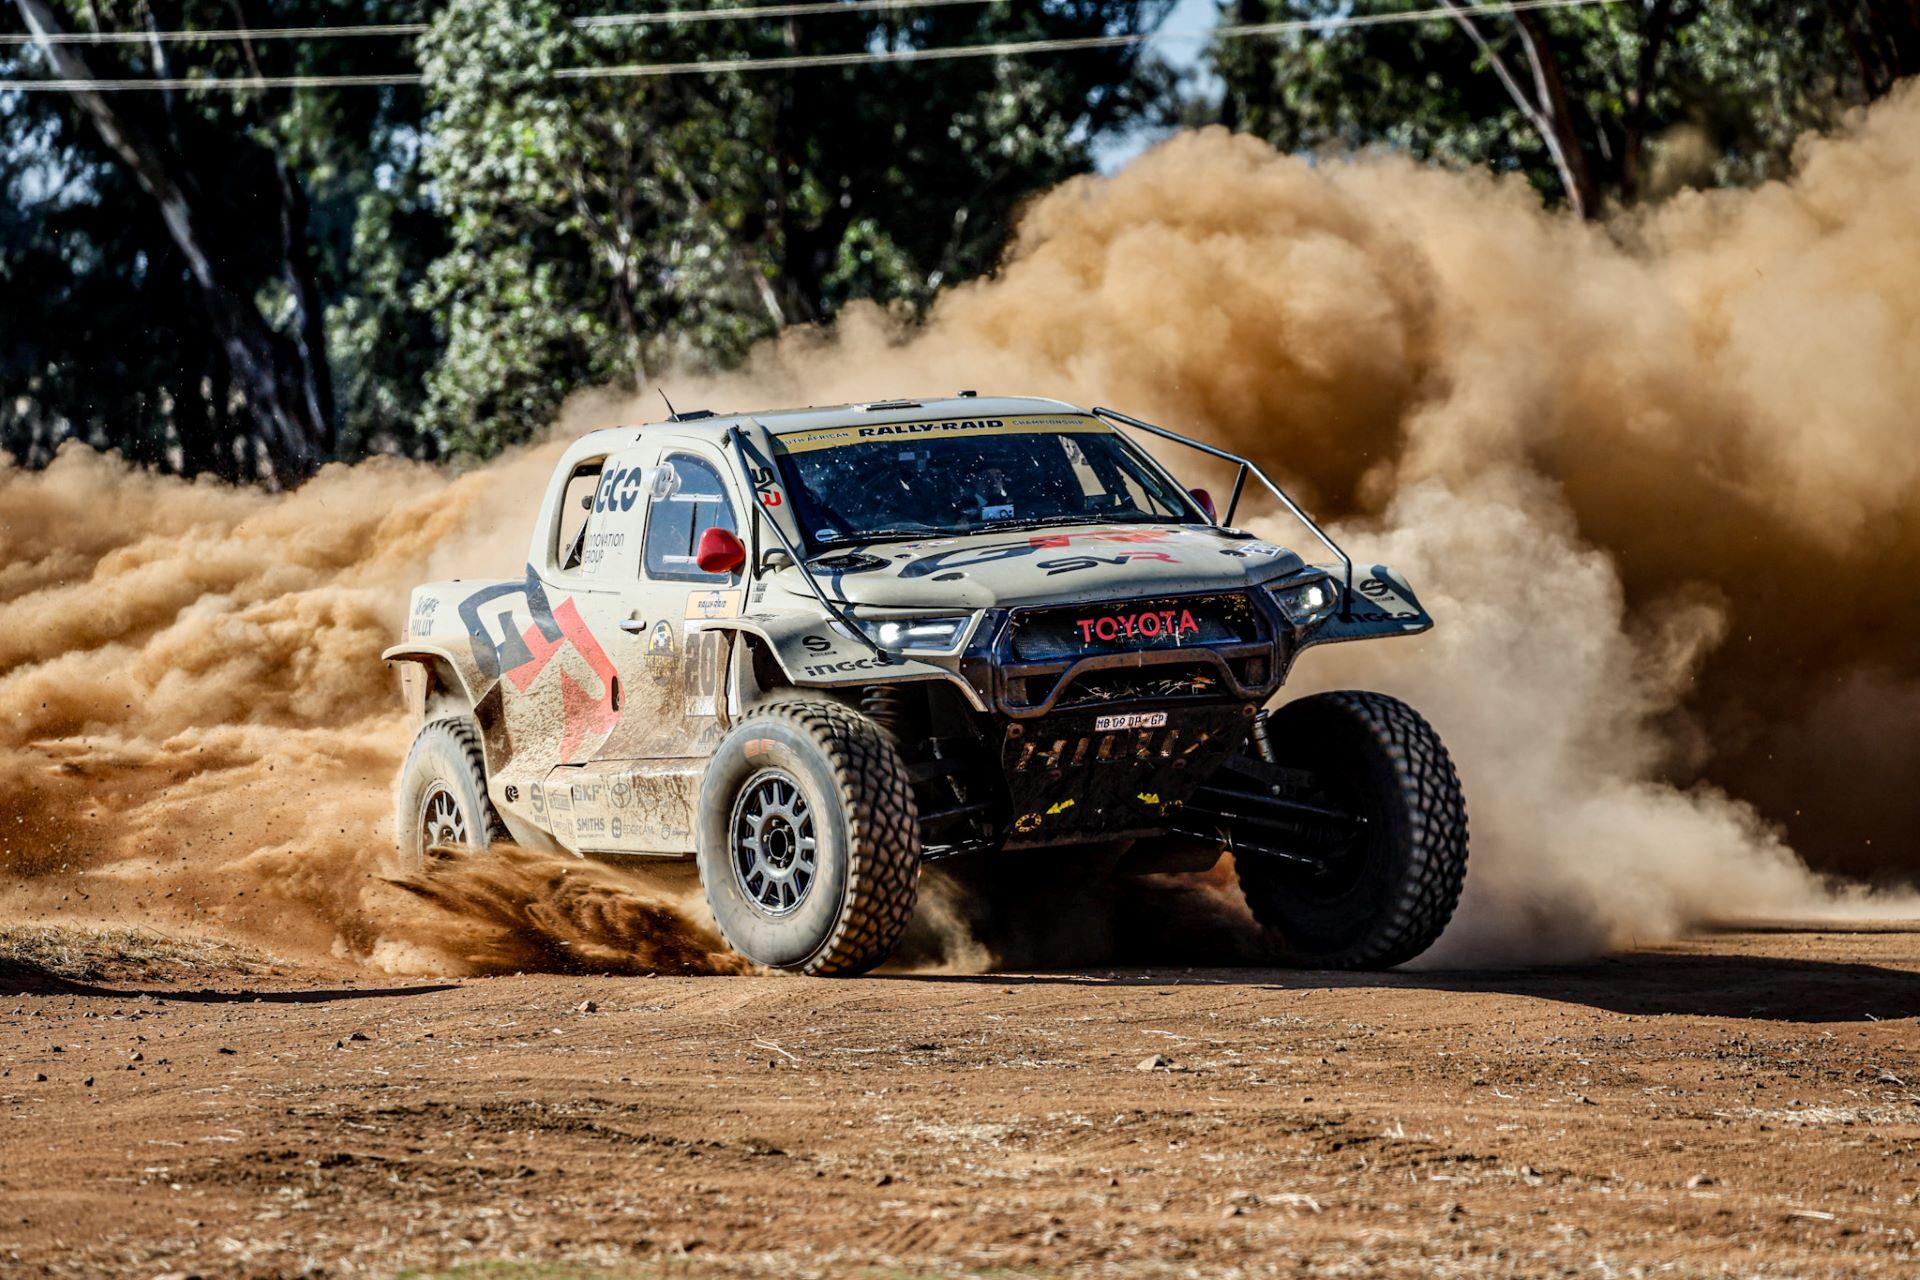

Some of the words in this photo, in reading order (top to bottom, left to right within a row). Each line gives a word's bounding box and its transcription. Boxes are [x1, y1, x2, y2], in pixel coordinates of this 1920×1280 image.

[858, 419, 1004, 437] RALLY-RAID
[1076, 609, 1199, 642] TOYOTA
[574, 784, 602, 801] SKF
[576, 816, 606, 833] SMITHS
